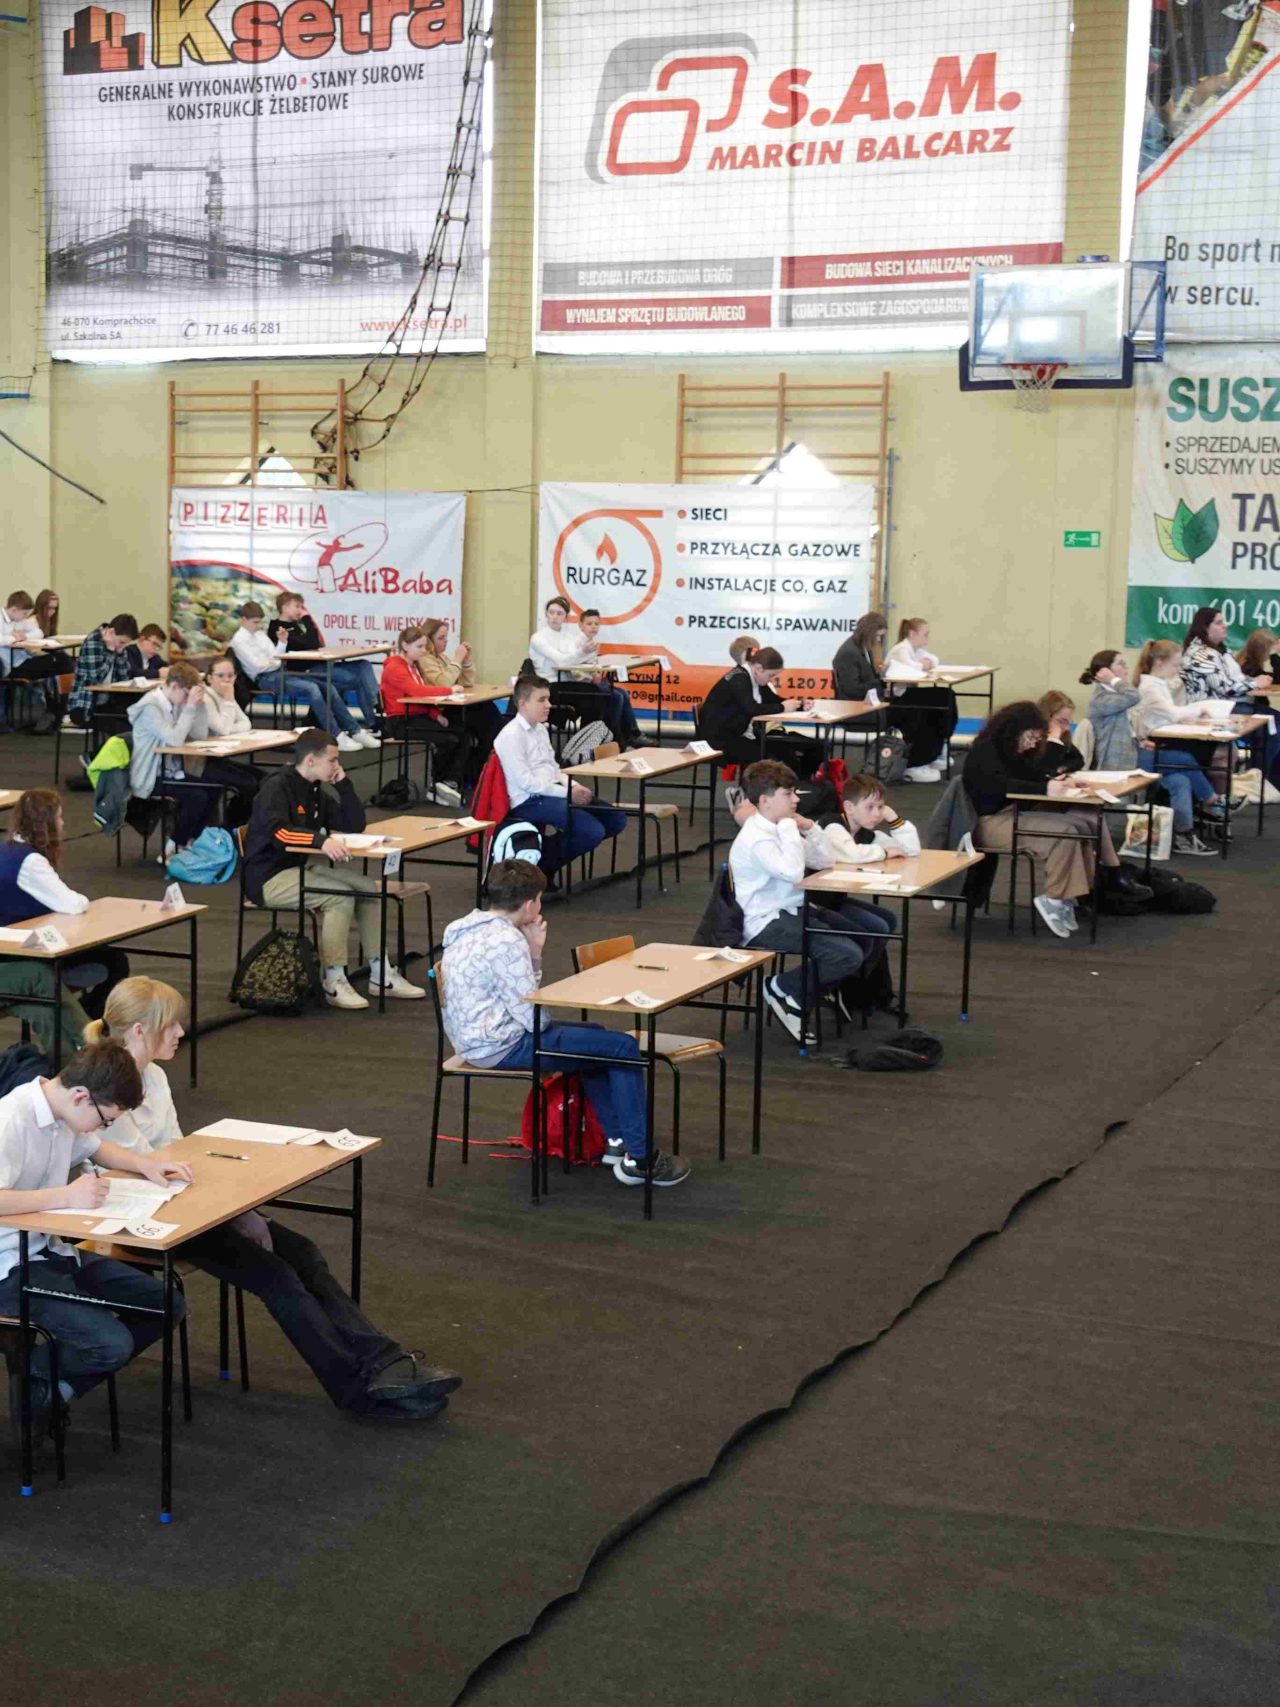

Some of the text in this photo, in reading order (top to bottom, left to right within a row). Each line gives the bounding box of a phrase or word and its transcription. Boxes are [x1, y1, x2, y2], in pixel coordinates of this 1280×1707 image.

[151, 0, 465, 69] Ksetra
[98, 63, 425, 103] GENERALNE WYKONAWSTWO STANY SUROWE
[762, 51, 1022, 130] S.A.M.
[167, 91, 349, 121] KONSTRUKCJE ŻELBETOWE
[706, 127, 1014, 171] MARCIN BALCARZ
[1164, 235, 1189, 262] Bo
[1198, 238, 1262, 269] sport
[578, 270, 621, 286] BUDOWA
[631, 268, 700, 285] PRZEBUDOWA
[703, 265, 733, 283] DRÓG
[825, 262, 871, 279] BUDOWA
[874, 260, 904, 277] SIECI
[1186, 285, 1260, 306] sercu.
[566, 305, 746, 325] WYNAJEM SPRZĘTU BUDOWLANEGO
[792, 301, 878, 319] KOMPLEKSOWE
[92, 316, 157, 328] Komprachcice
[205, 322, 281, 336] 77 46 46 281
[360, 314, 467, 332] www.ksetra.pl
[1174, 458, 1256, 475] SUSZYMY
[182, 501, 328, 528] PIZZERIA
[691, 508, 728, 521] SIECI
[690, 542, 861, 560] PRZYŁĄCZA GAZOWE
[339, 566, 453, 595] AliBaba
[566, 566, 647, 588] RURGAZ
[688, 577, 776, 595] INSTALACJE
[813, 579, 848, 593] GAZ
[1208, 598, 1247, 626] 01
[323, 614, 361, 631] OPOLE,
[383, 616, 424, 632] WIEJSK
[688, 614, 857, 633] PRZECISKI, SPAWANIE
[665, 674, 680, 685] 12
[787, 677, 816, 689] 120
[336, 1136, 360, 1150] 65
